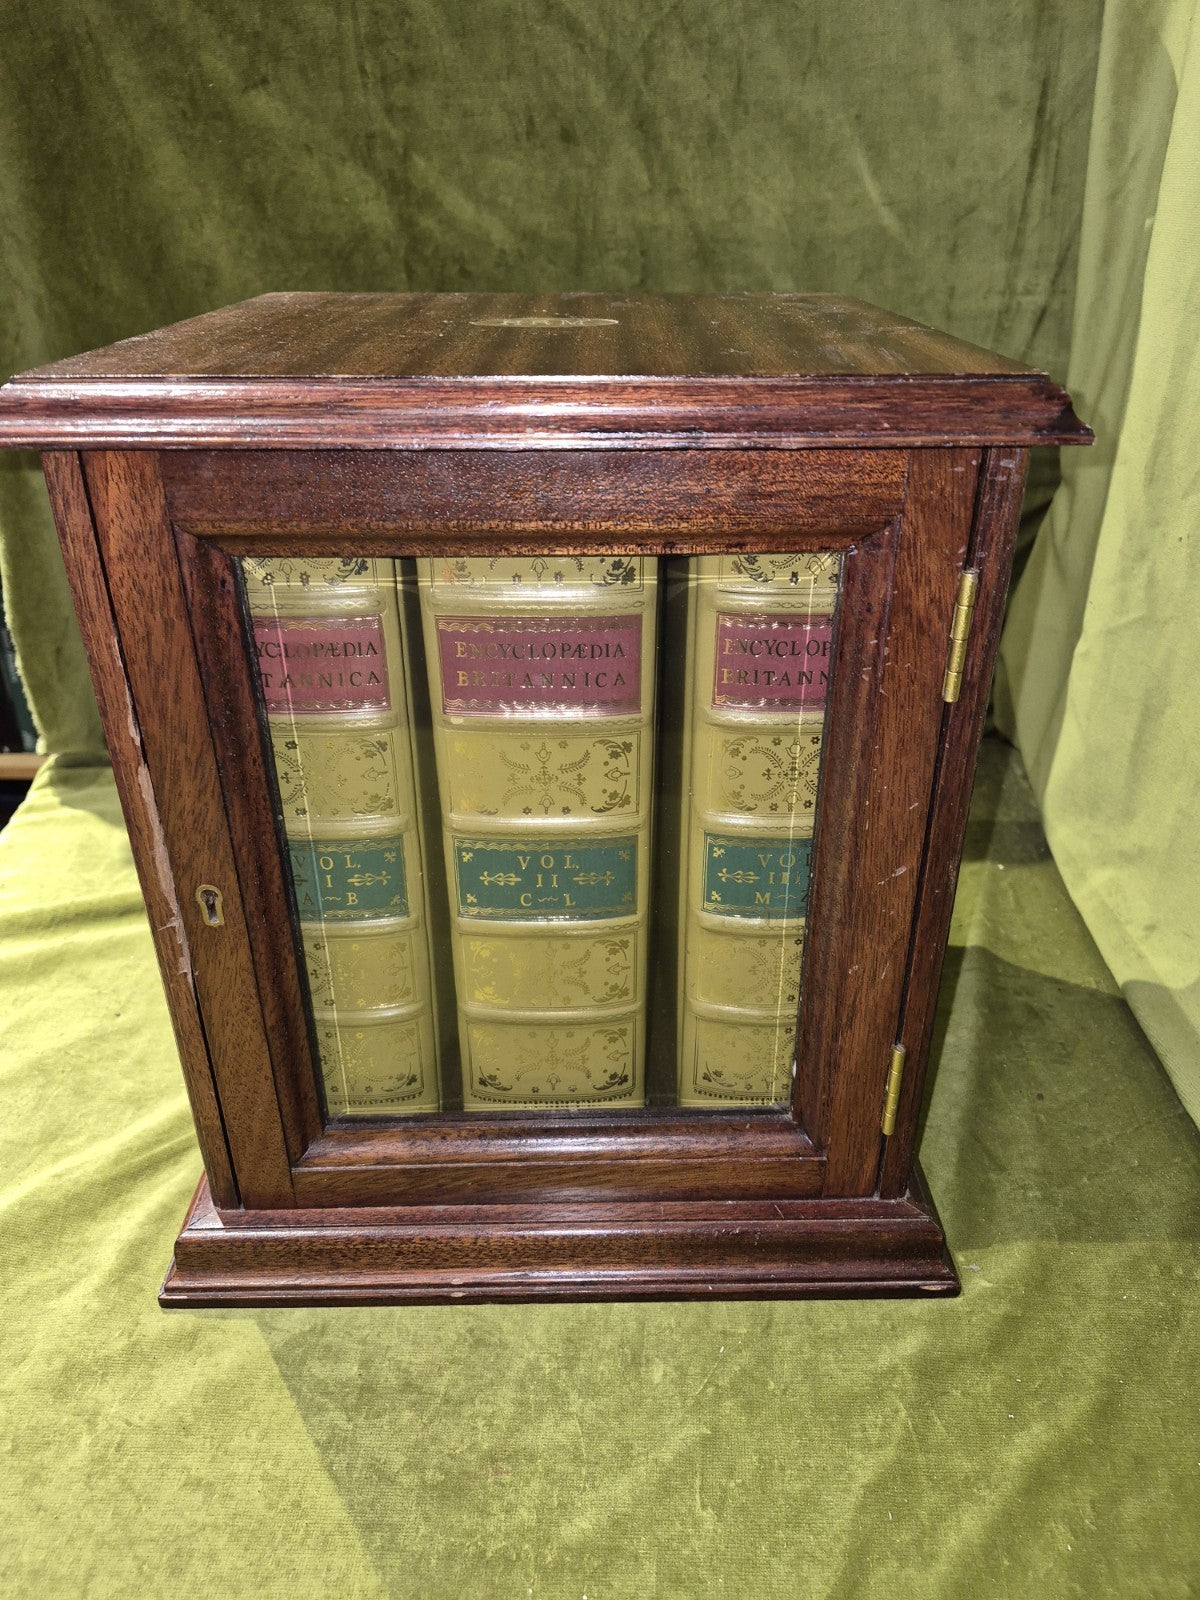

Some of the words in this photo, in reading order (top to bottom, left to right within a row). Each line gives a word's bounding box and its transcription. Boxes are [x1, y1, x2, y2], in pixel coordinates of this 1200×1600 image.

[455, 641, 626, 659] ENCYCLOPÆDIA
[457, 671, 626, 688] BRITANNICA
[326, 875, 333, 888] I
[536, 874, 558, 888] II
